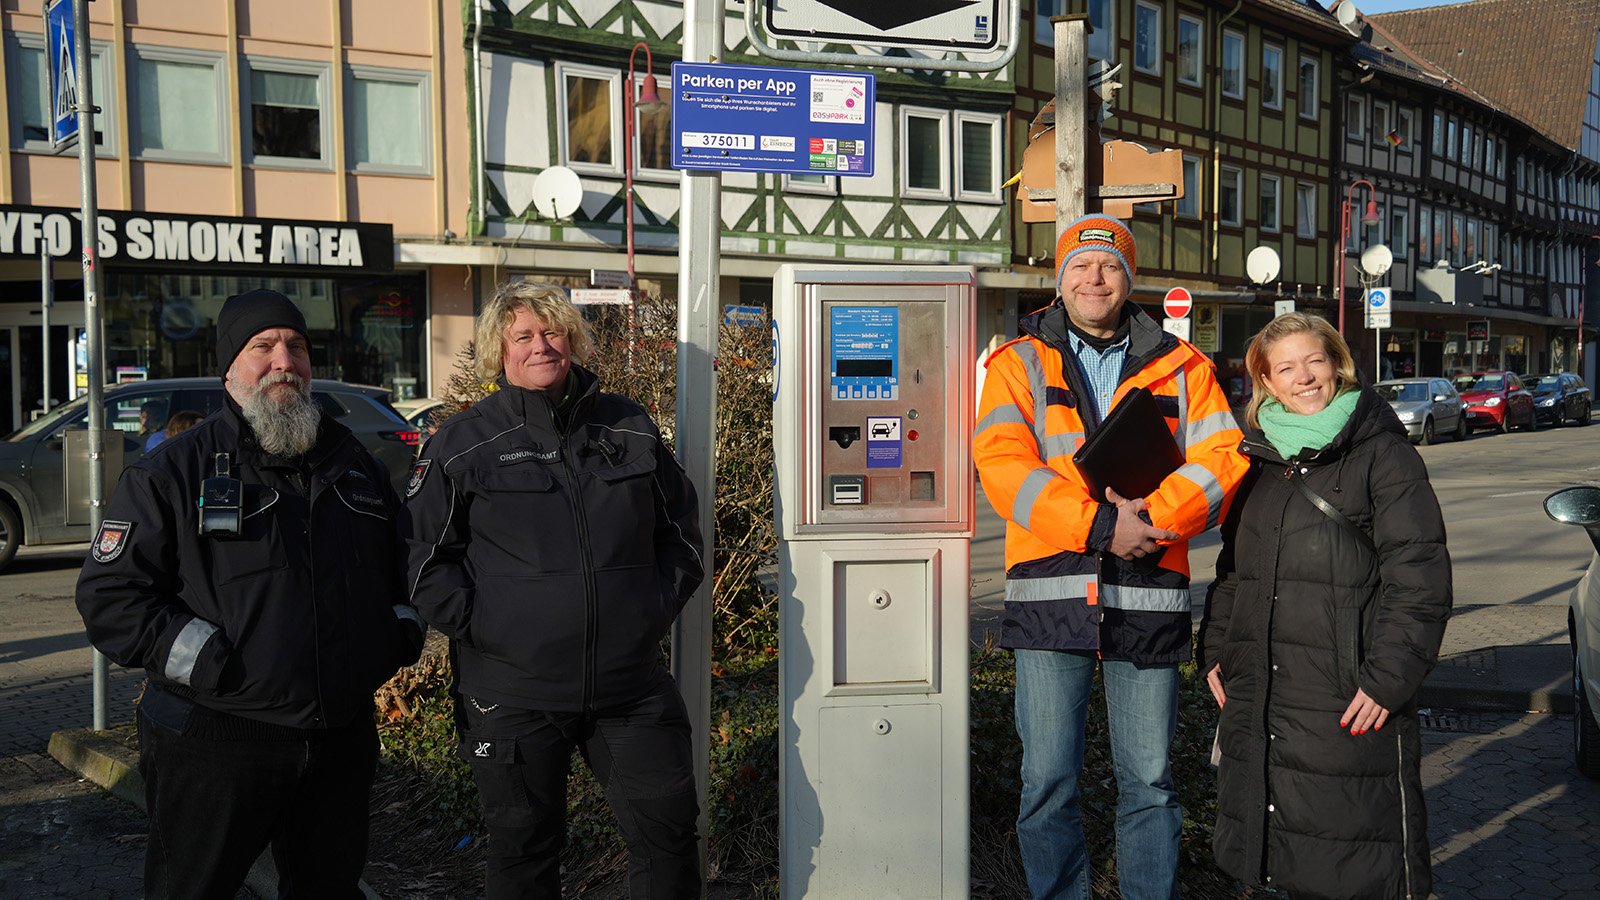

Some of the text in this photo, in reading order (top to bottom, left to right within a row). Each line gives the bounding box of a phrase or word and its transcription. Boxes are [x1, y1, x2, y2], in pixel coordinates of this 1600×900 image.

[682, 74, 735, 89] Parken
[738, 79, 764, 93] per
[766, 79, 797, 96] App
[703, 134, 747, 148] 375011
[125, 216, 263, 264] SMOKE
[270, 225, 364, 267] AREA
[499, 450, 557, 462] ORDNUNGSAMT
